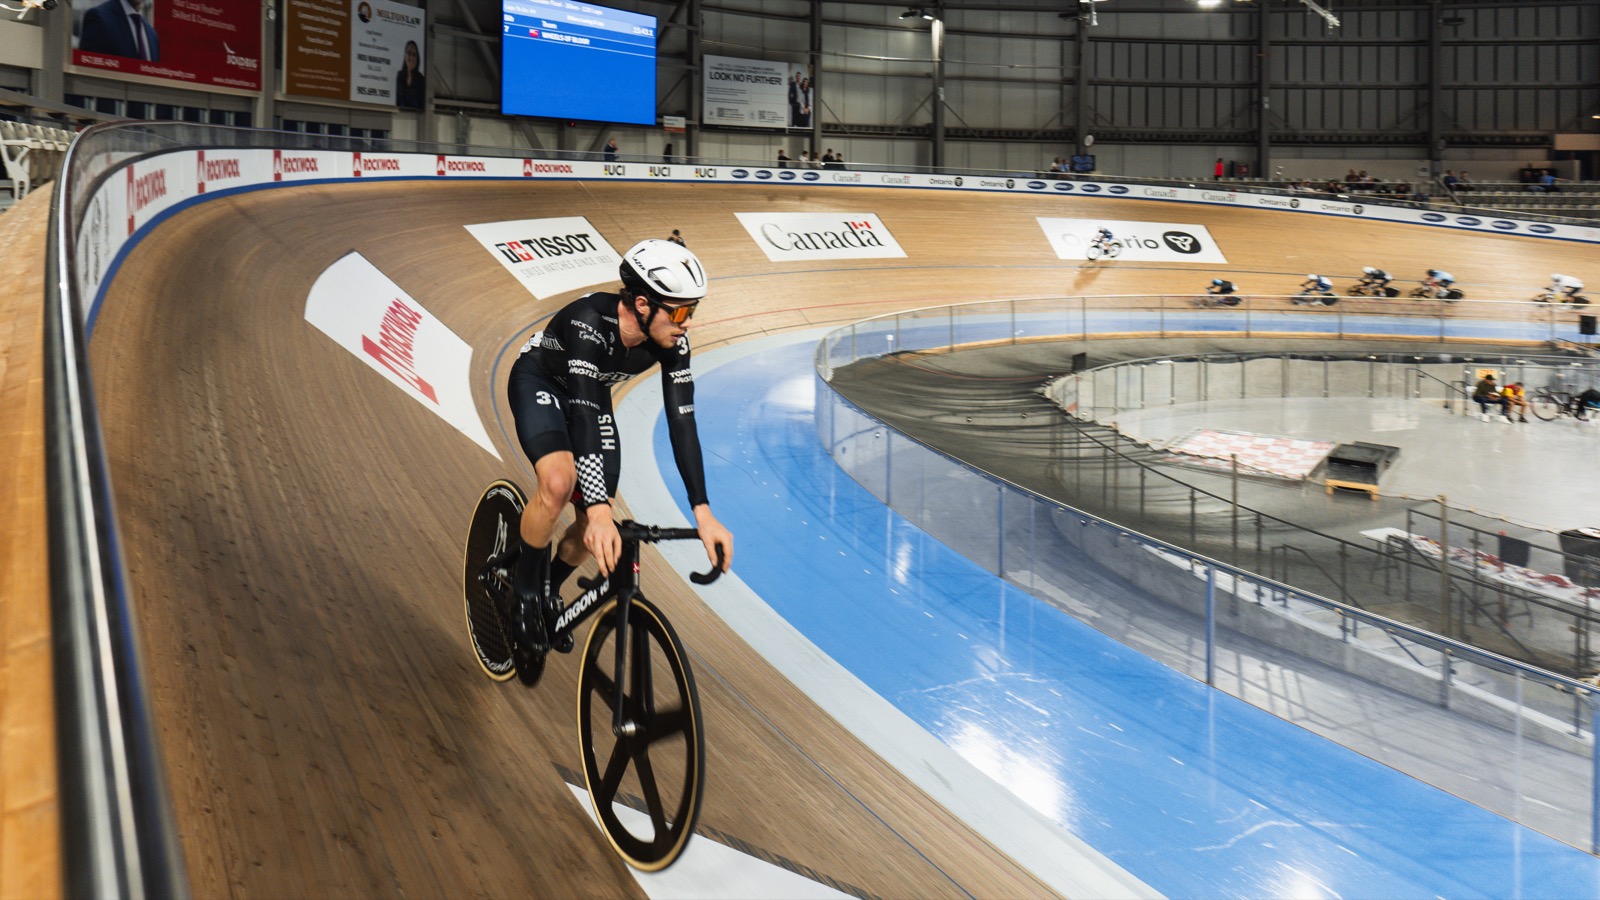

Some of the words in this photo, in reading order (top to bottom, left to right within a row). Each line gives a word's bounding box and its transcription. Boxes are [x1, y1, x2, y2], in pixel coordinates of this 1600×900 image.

[709, 71, 733, 82] LOOK
[733, 74, 745, 83] NO
[207, 158, 239, 181] ROCKWOOL
[283, 157, 318, 173] ROCKWOOL
[363, 158, 399, 171] ROCKWOOL
[447, 160, 485, 172] ROCKWOOL
[534, 163, 571, 174] ROCKWOOL
[608, 165, 625, 176] UCI
[653, 167, 671, 177] UCI
[699, 168, 717, 178] UCI
[832, 172, 861, 183] Canada
[881, 174, 911, 184] Canada
[980, 180, 1005, 188] Ontario
[136, 169, 166, 210] ROCKWOOL
[1143, 187, 1177, 199] Canada
[1201, 191, 1236, 203] Canada
[760, 221, 885, 252] Canada
[1061, 233, 1159, 250] Oario
[519, 233, 598, 259] TISSOT
[378, 297, 423, 369] ROCKWOOL
[567, 359, 599, 373] TORONT
[568, 398, 600, 411] ARATHO
[554, 588, 598, 633] ARGON
